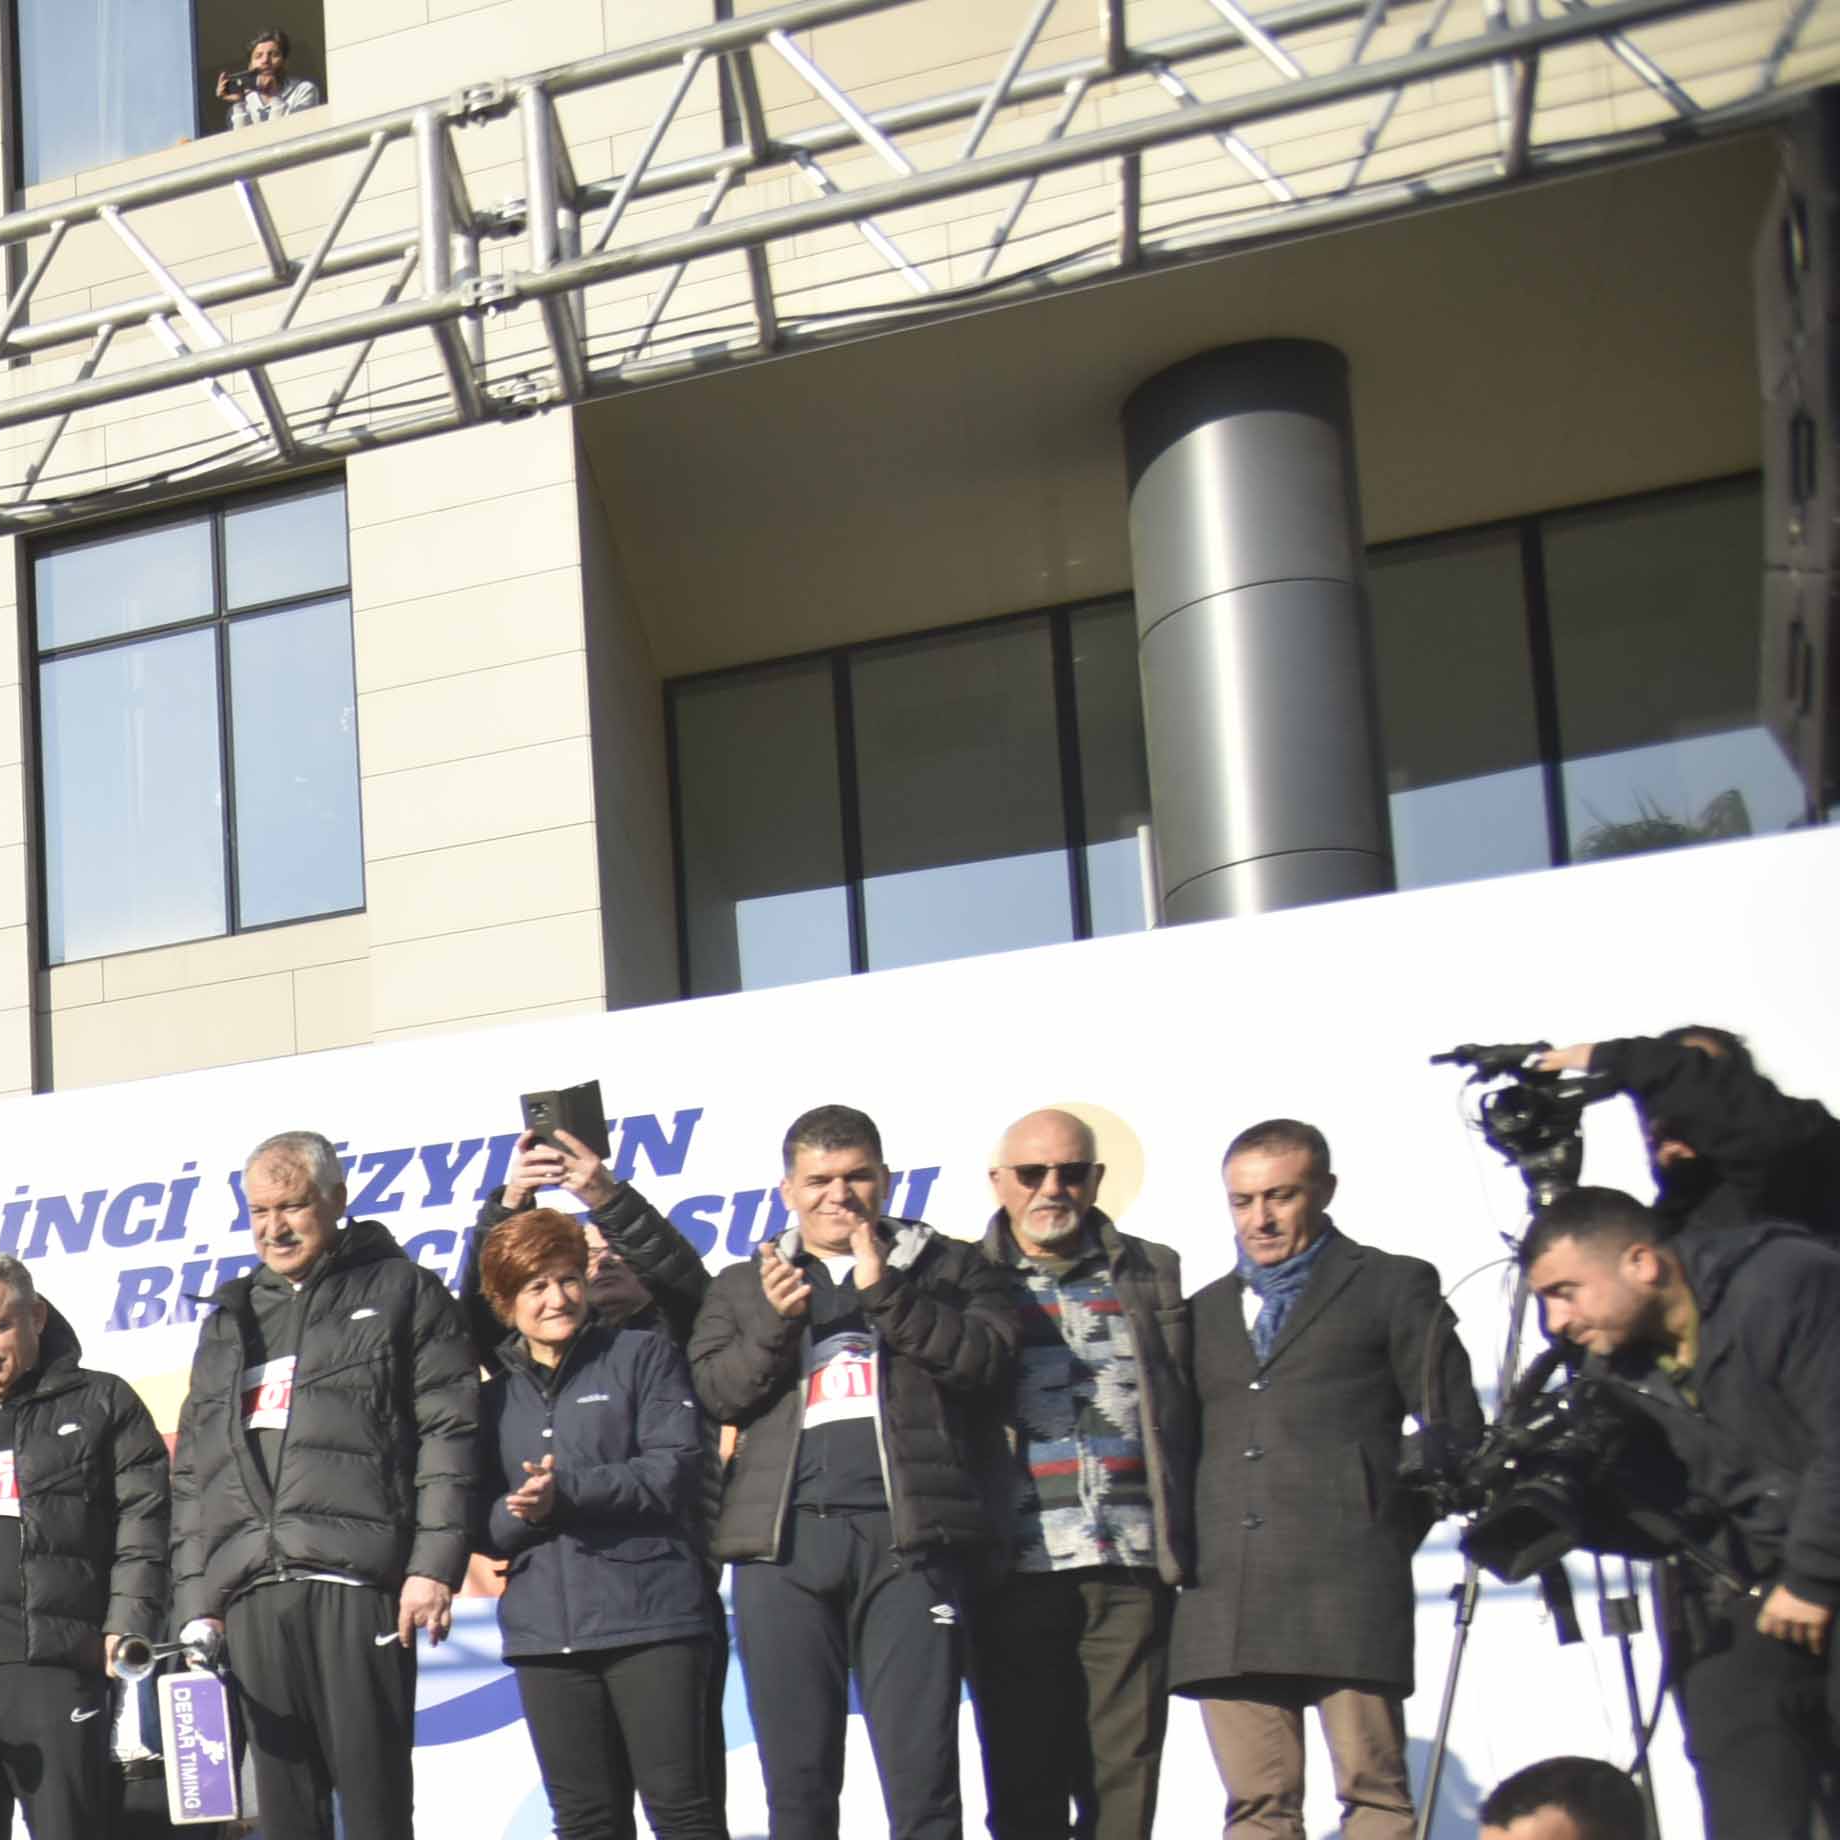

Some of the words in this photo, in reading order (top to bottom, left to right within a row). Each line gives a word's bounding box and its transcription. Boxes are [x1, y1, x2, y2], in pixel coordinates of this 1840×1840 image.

[826, 1374, 873, 1400] 01
[173, 1686, 196, 1748] DEPAR
[180, 1748, 203, 1810] TIMING
